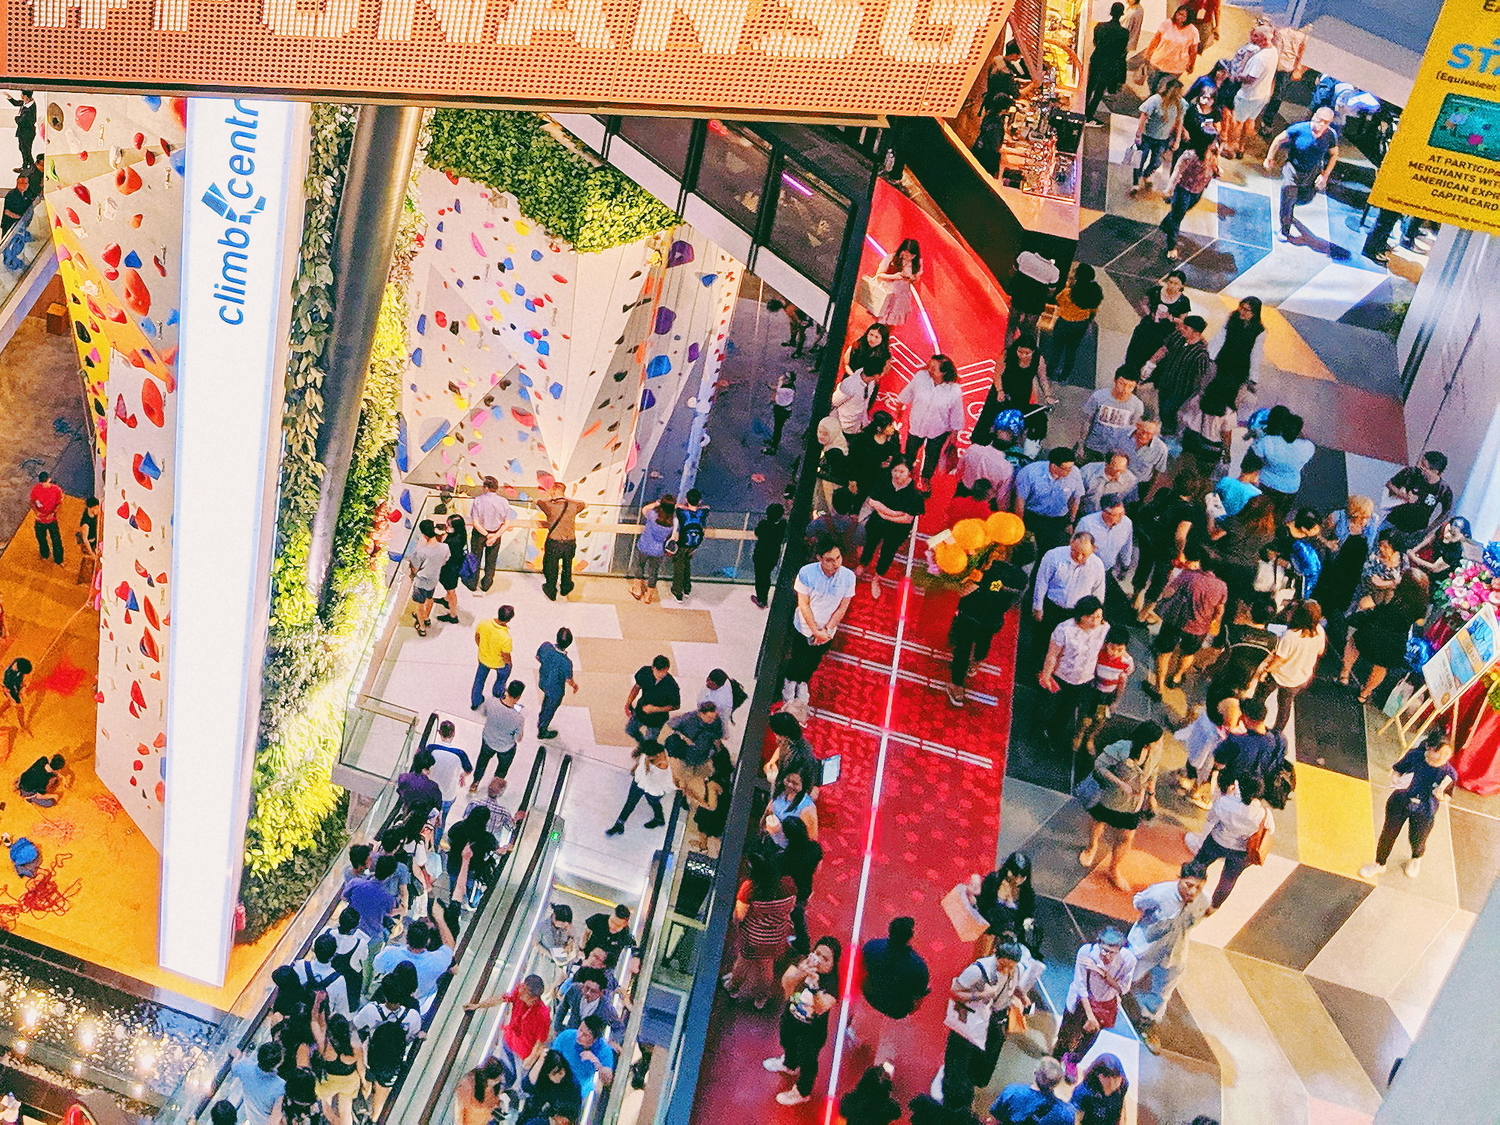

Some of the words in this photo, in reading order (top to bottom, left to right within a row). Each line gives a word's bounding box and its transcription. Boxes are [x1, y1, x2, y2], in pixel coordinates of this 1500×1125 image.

[1428, 155, 1442, 163] AT
[1408, 160, 1476, 183] MERCHANTS
[1479, 177, 1500, 189] WIT
[1411, 173, 1470, 193] AMERICAN
[1431, 188, 1499, 211] CAPITACARD
